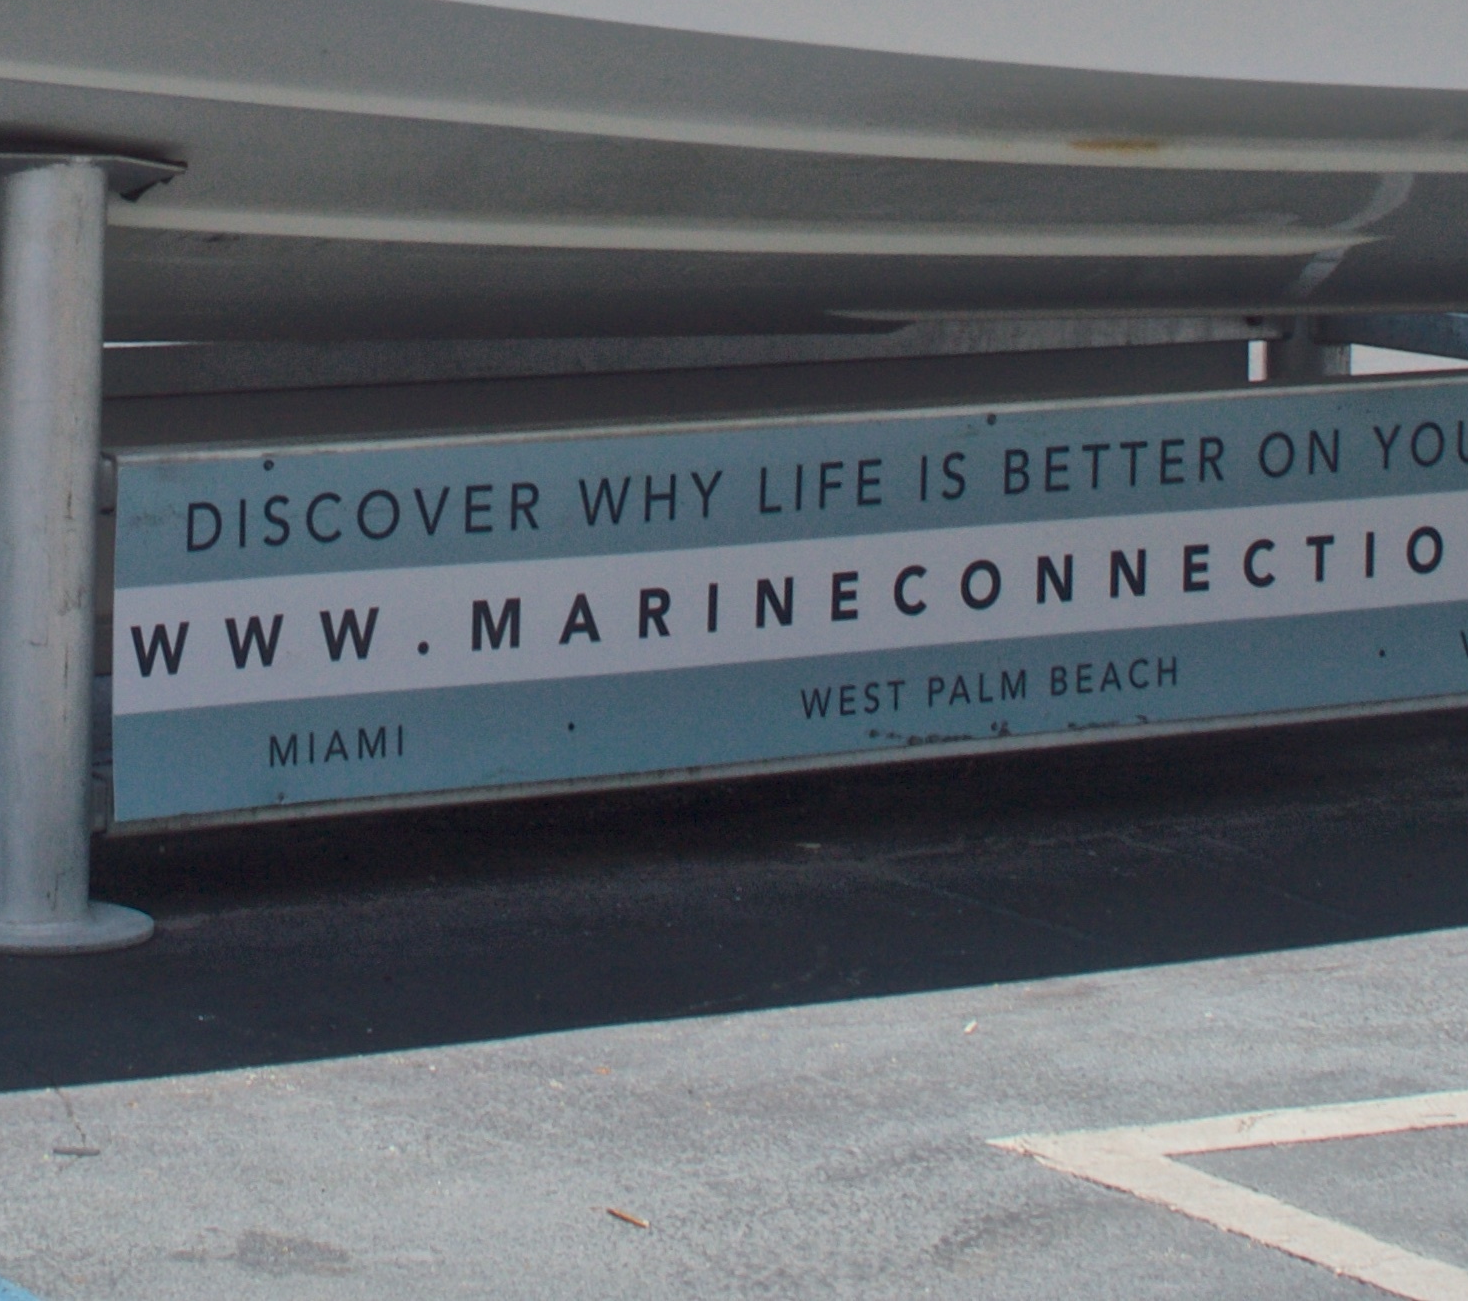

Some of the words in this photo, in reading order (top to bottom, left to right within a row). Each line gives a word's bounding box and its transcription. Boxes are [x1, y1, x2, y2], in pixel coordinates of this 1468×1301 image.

[187, 482, 539, 551] DISCOVER
[579, 470, 723, 526] WHY
[759, 458, 882, 515] LIFE
[919, 452, 966, 501] IS
[1003, 437, 1225, 495] BETTER
[1258, 429, 1340, 478] ON
[801, 680, 903, 720] WEST
[927, 669, 1027, 708] PALM
[1050, 656, 1178, 697] BEACH
[269, 725, 405, 767] MIAMI
